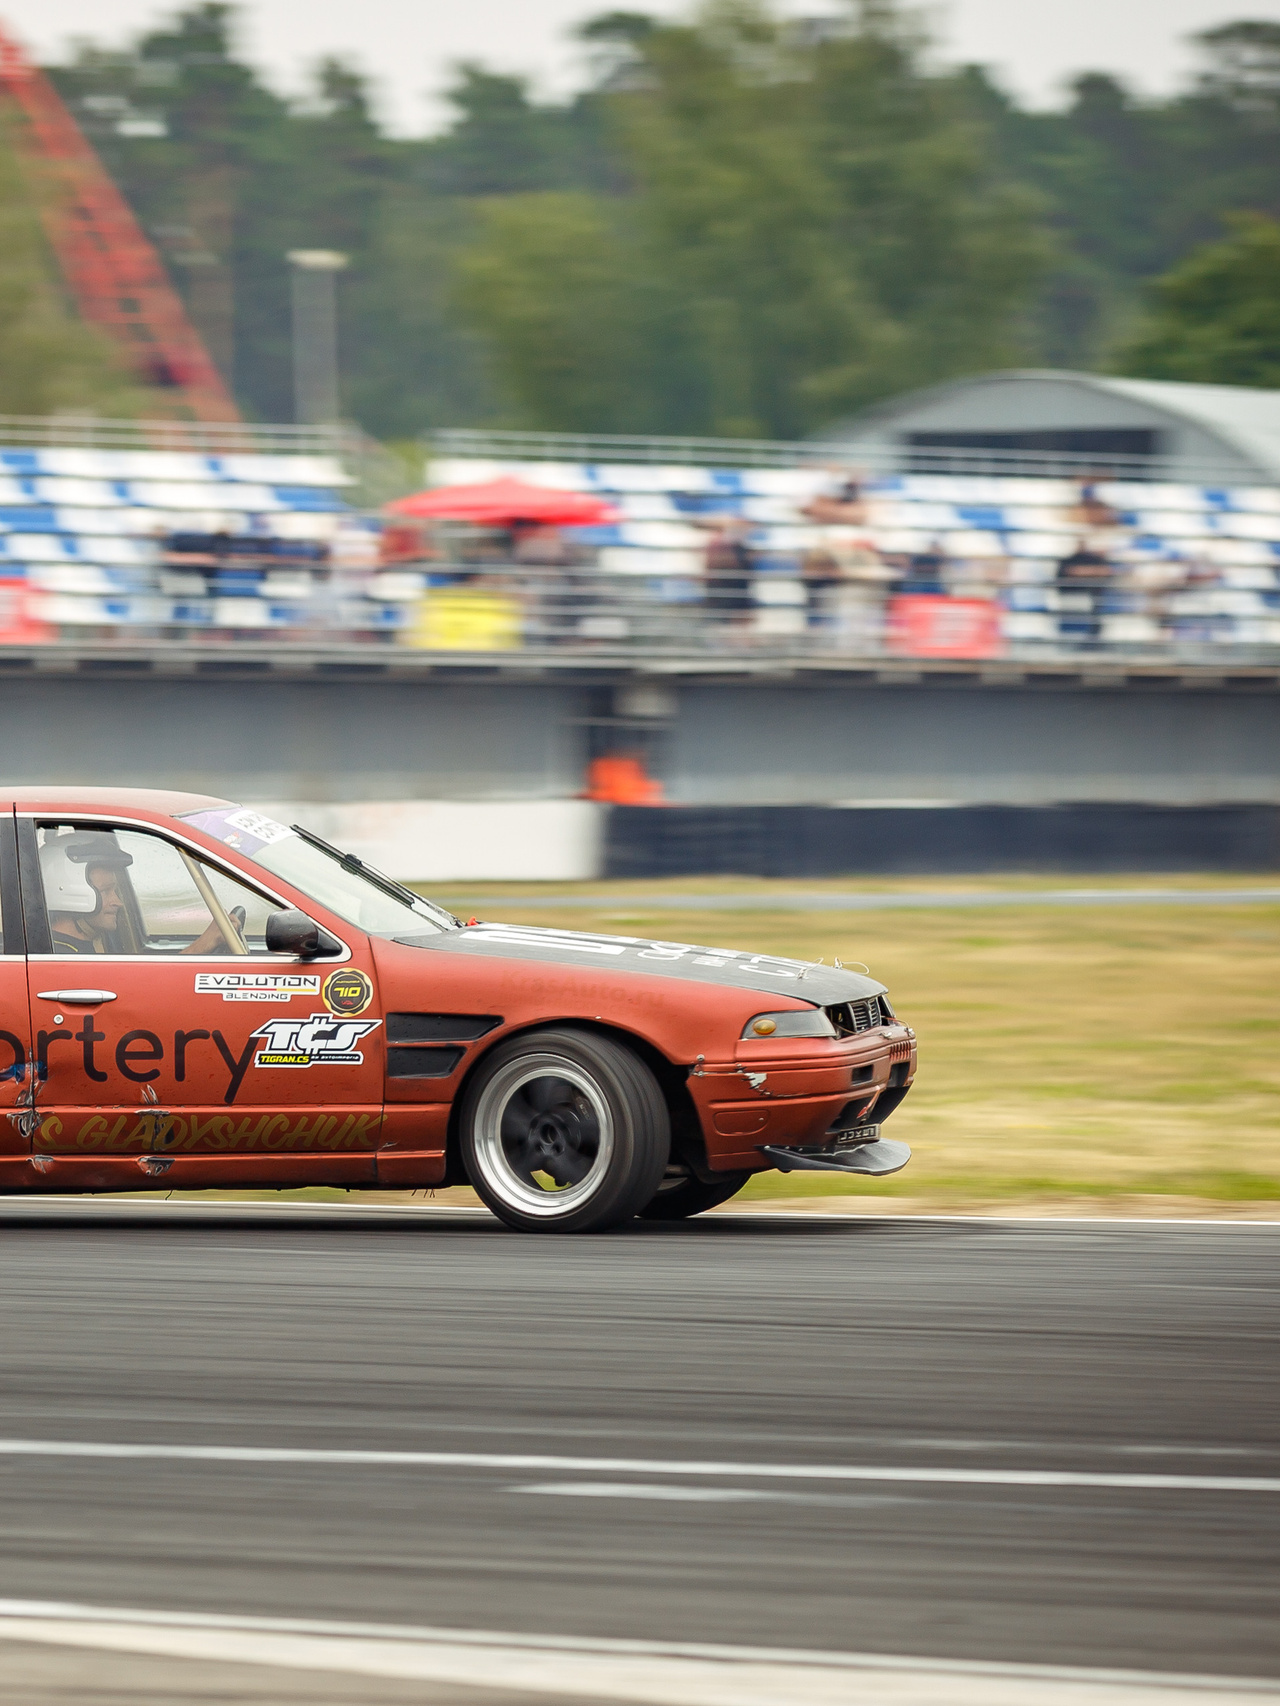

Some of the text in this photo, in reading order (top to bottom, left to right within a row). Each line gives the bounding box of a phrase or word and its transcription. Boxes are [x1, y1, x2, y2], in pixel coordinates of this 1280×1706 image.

[198, 975, 317, 987] EVOLUTION
[225, 992, 289, 1000] BLENDING
[260, 1055, 310, 1064] TIGRAN.CS
